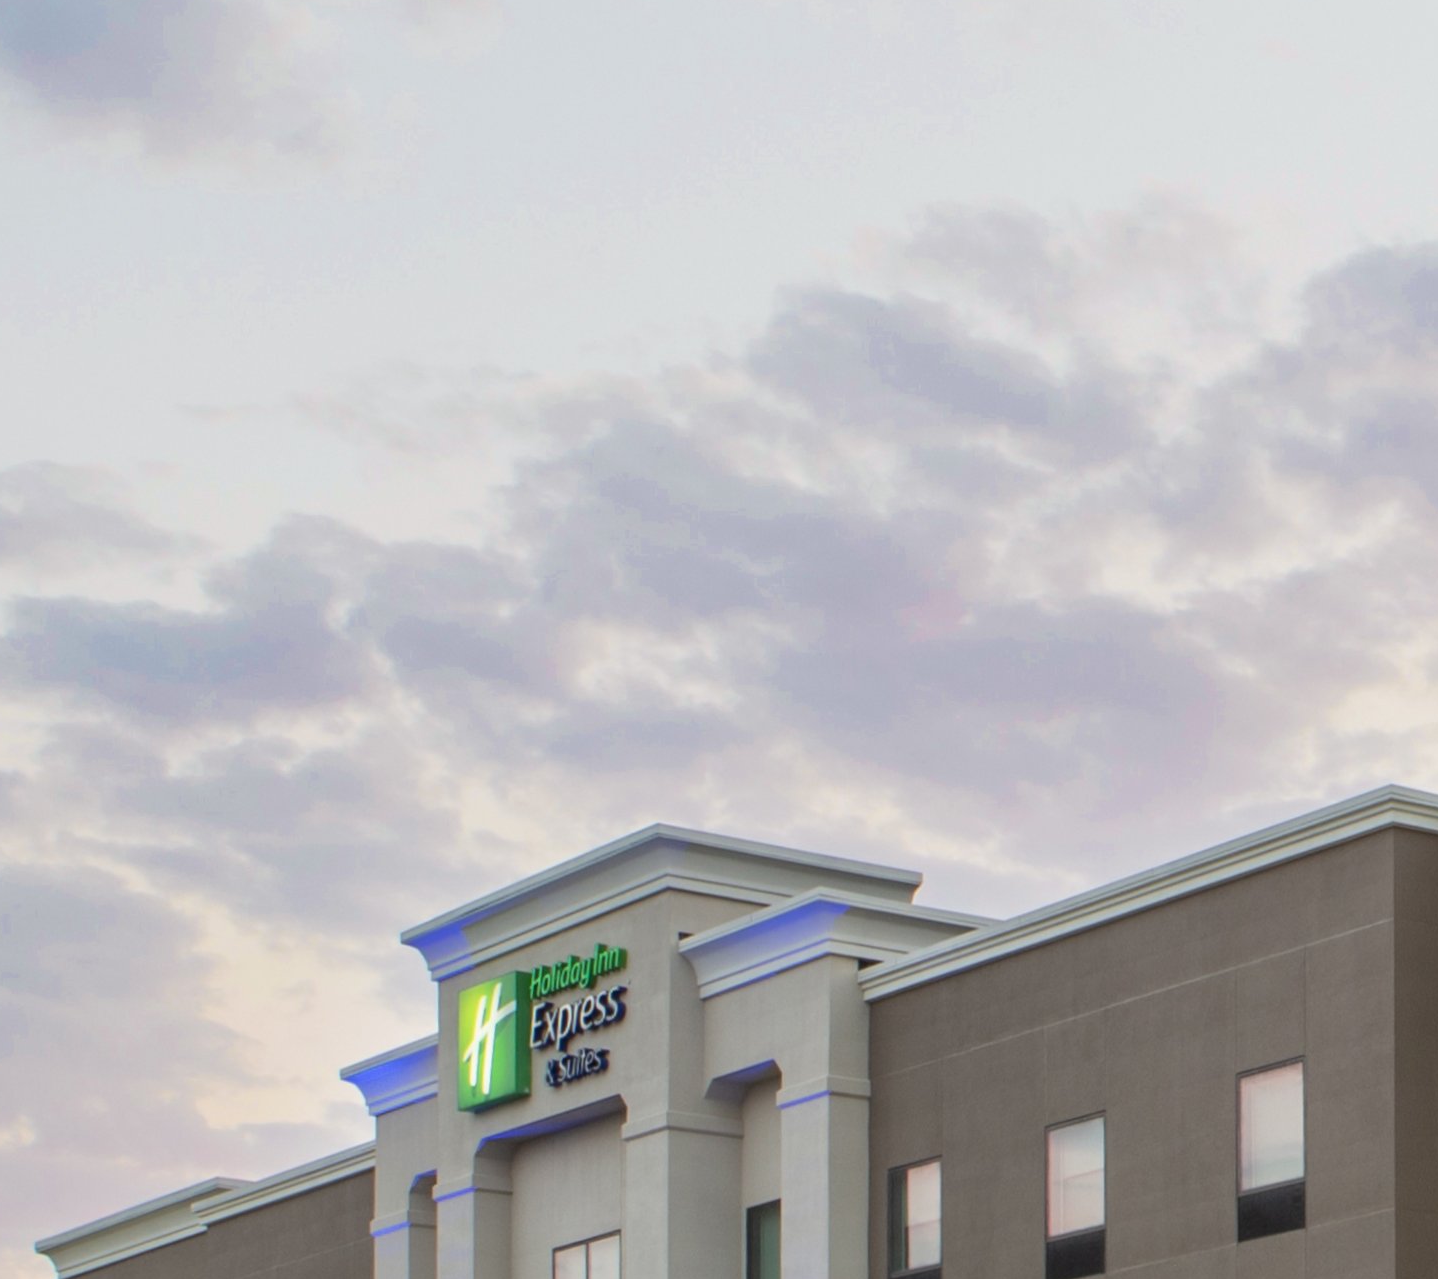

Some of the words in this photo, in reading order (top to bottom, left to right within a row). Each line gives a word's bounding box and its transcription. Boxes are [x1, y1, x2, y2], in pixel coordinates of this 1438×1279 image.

[530, 954, 593, 999] Holiday
[593, 943, 627, 976] Inn
[530, 986, 627, 1052] Express
[558, 1048, 610, 1083] Suites
